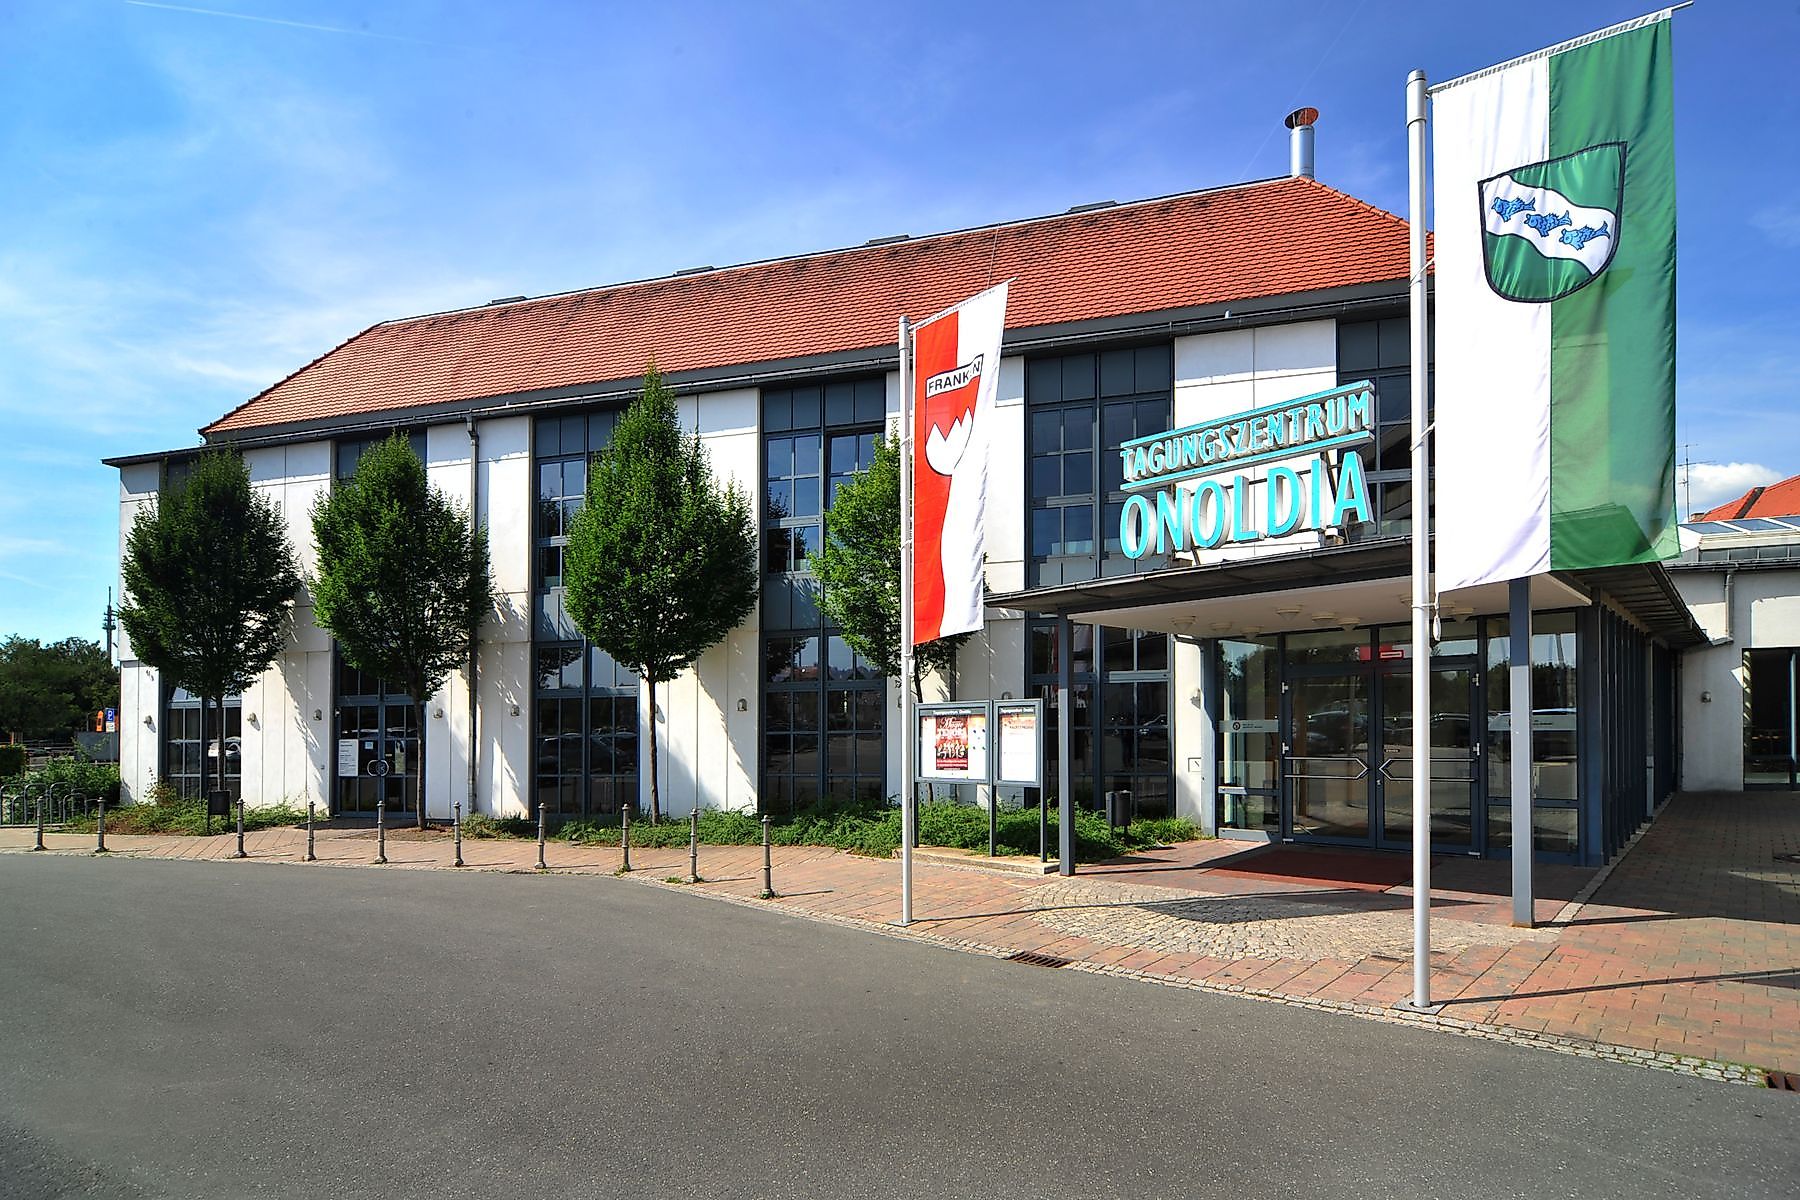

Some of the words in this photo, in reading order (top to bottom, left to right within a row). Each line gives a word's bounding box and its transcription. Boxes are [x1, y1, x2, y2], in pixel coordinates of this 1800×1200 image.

[928, 361, 981, 393] FRANKN
[1120, 390, 1373, 481] TAGUNGSZENTRUM
[1120, 451, 1374, 560] ONOLDIA
